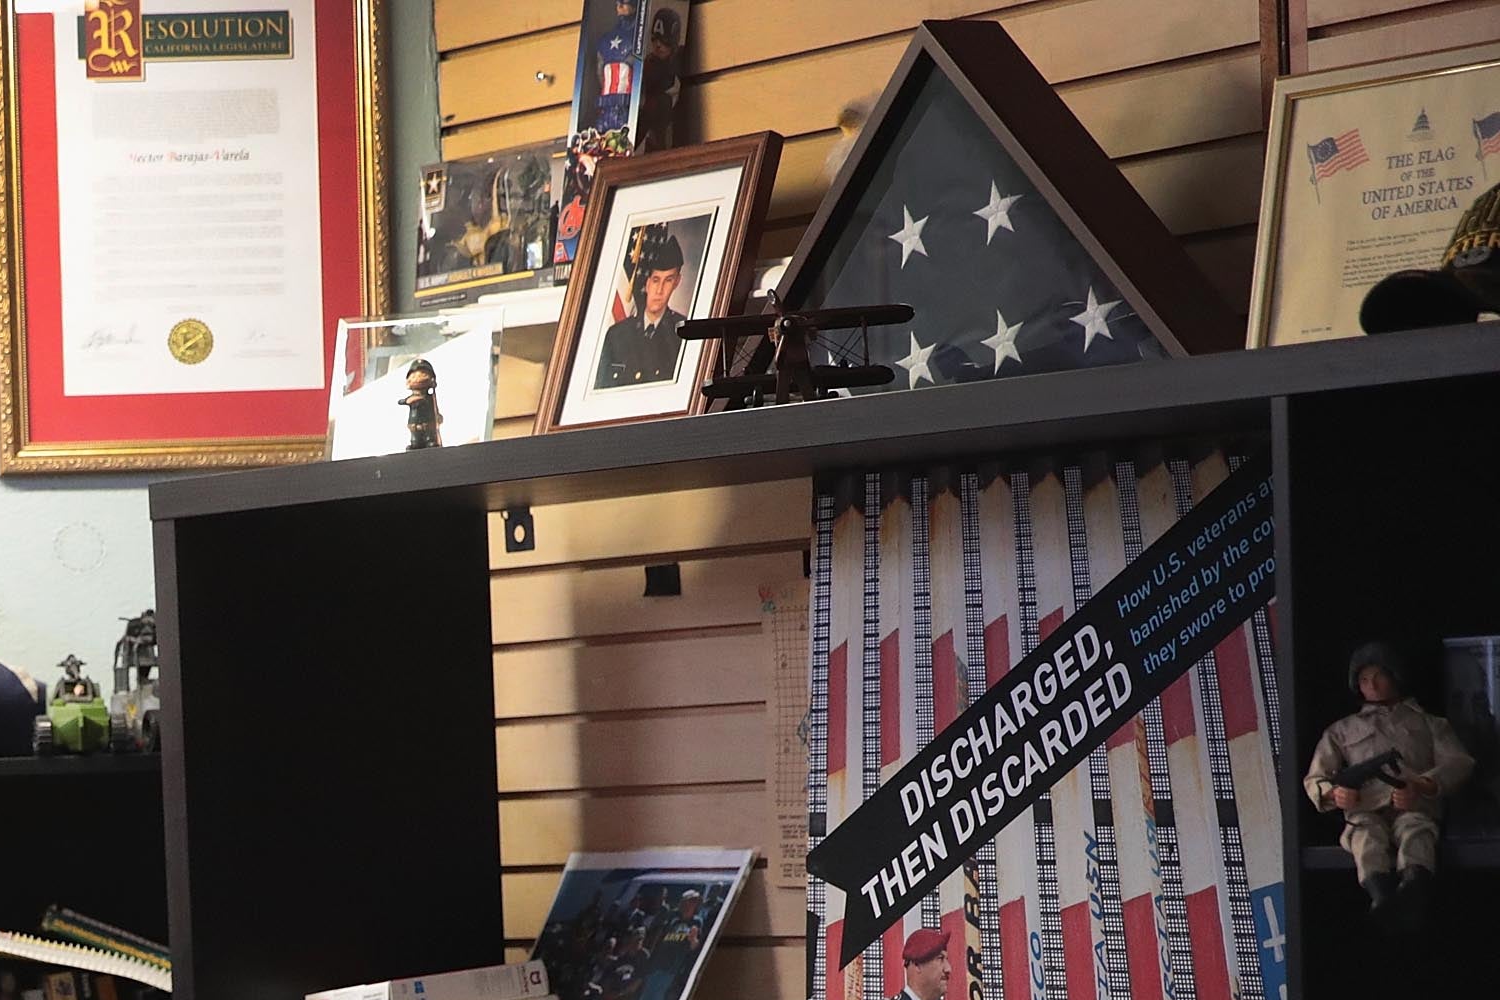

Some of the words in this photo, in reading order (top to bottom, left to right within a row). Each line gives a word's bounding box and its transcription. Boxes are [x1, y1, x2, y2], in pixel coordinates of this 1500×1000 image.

[88, 8, 284, 60] RESOLUTION
[145, 43, 210, 54] CALIFORNIA
[213, 41, 285, 53] LEGISLATURE
[1386, 153, 1414, 170] THE
[1418, 146, 1456, 165] FLAG
[1400, 171, 1413, 182] OF
[1417, 168, 1436, 180] THE
[1362, 184, 1414, 204] UNITED
[1418, 176, 1475, 195] STATES
[1371, 206, 1391, 220] OF
[1394, 196, 1459, 218] AMERICA
[1117, 578, 1151, 618] How
[1153, 552, 1187, 586] U.S.
[1187, 492, 1256, 557] veterans
[1129, 575, 1200, 647] banished
[1201, 560, 1220, 587] by
[1223, 538, 1250, 567] the
[1142, 636, 1176, 674] they
[1179, 597, 1227, 646] swore
[1228, 581, 1245, 603] to
[1248, 556, 1276, 593] pro
[900, 623, 1115, 827] DISCHARGED,
[861, 819, 953, 919] THEN
[950, 663, 1133, 844] DISCARDED
